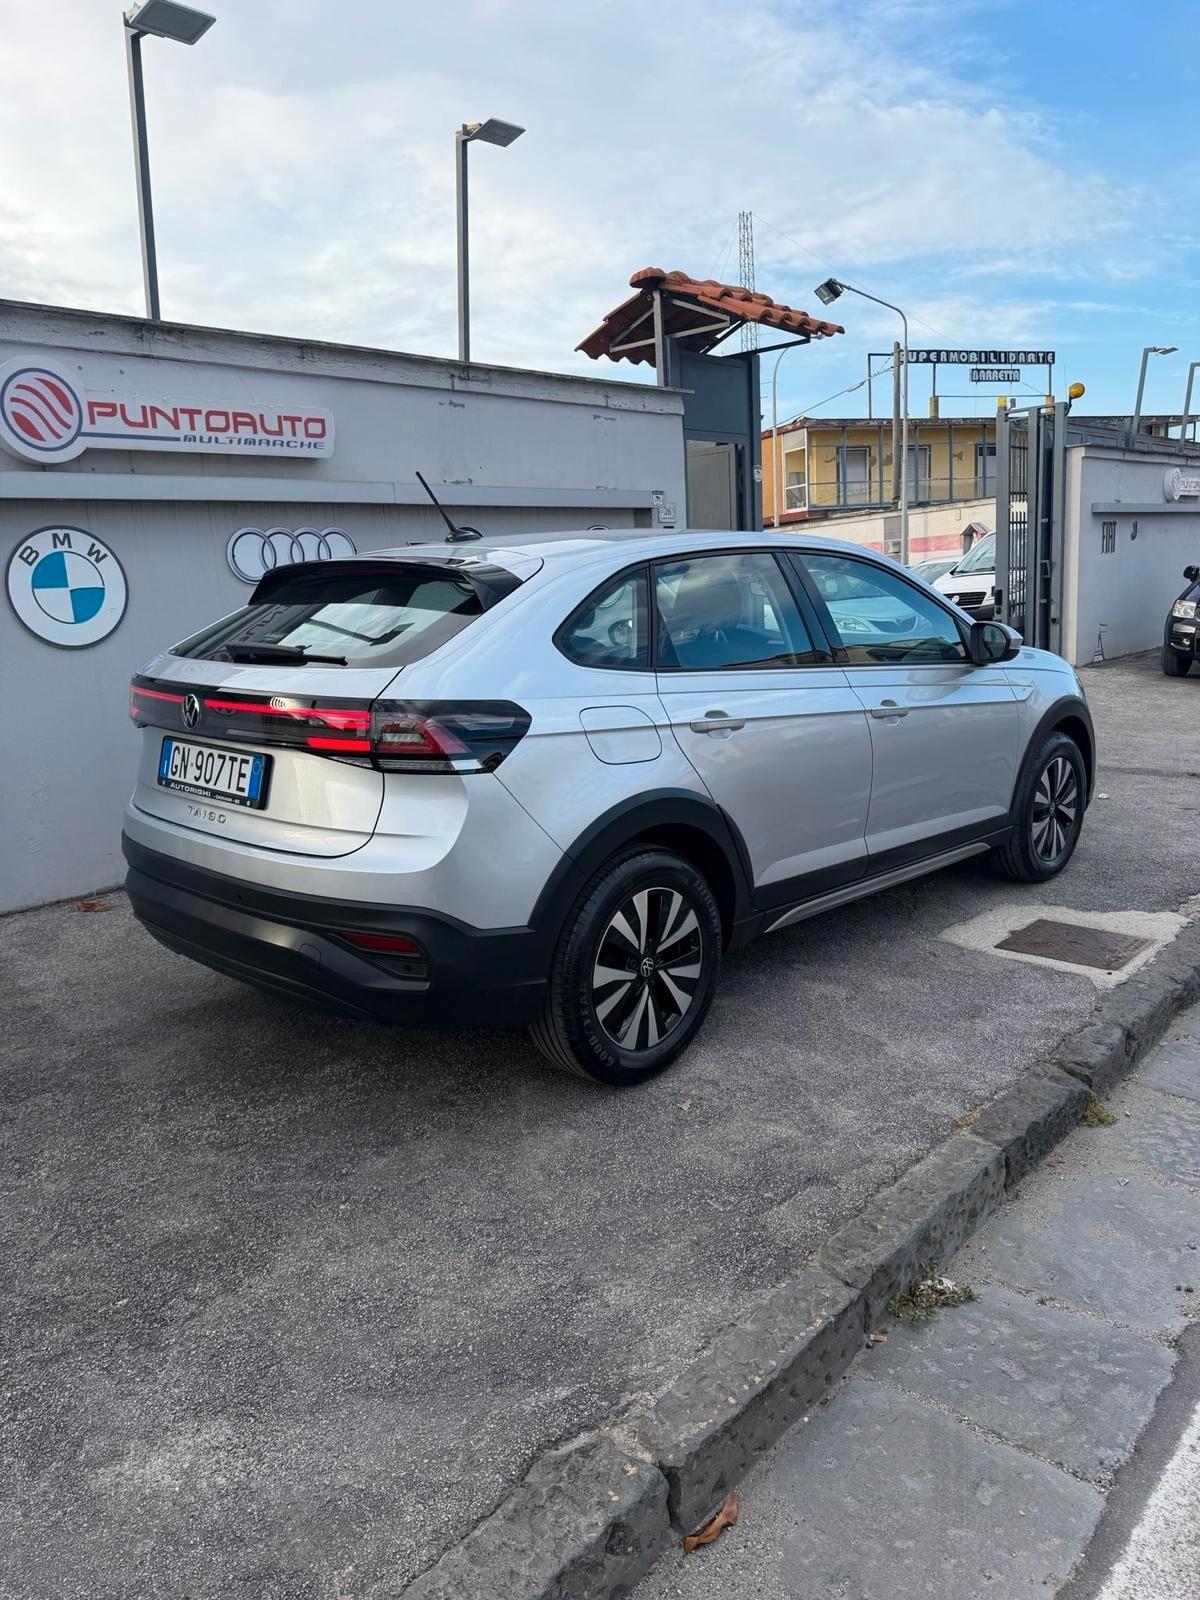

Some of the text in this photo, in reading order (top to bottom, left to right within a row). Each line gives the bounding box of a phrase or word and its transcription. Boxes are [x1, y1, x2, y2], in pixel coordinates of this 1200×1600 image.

[972, 369, 1020, 381] BARRETTA
[86, 401, 327, 439] PUNTOAUTO
[182, 434, 326, 450] MULTIMARCHE
[18, 532, 108, 567] BMW
[1101, 520, 1118, 554] FIAT
[193, 749, 251, 794] 907TE
[187, 805, 227, 824] TAIGO
